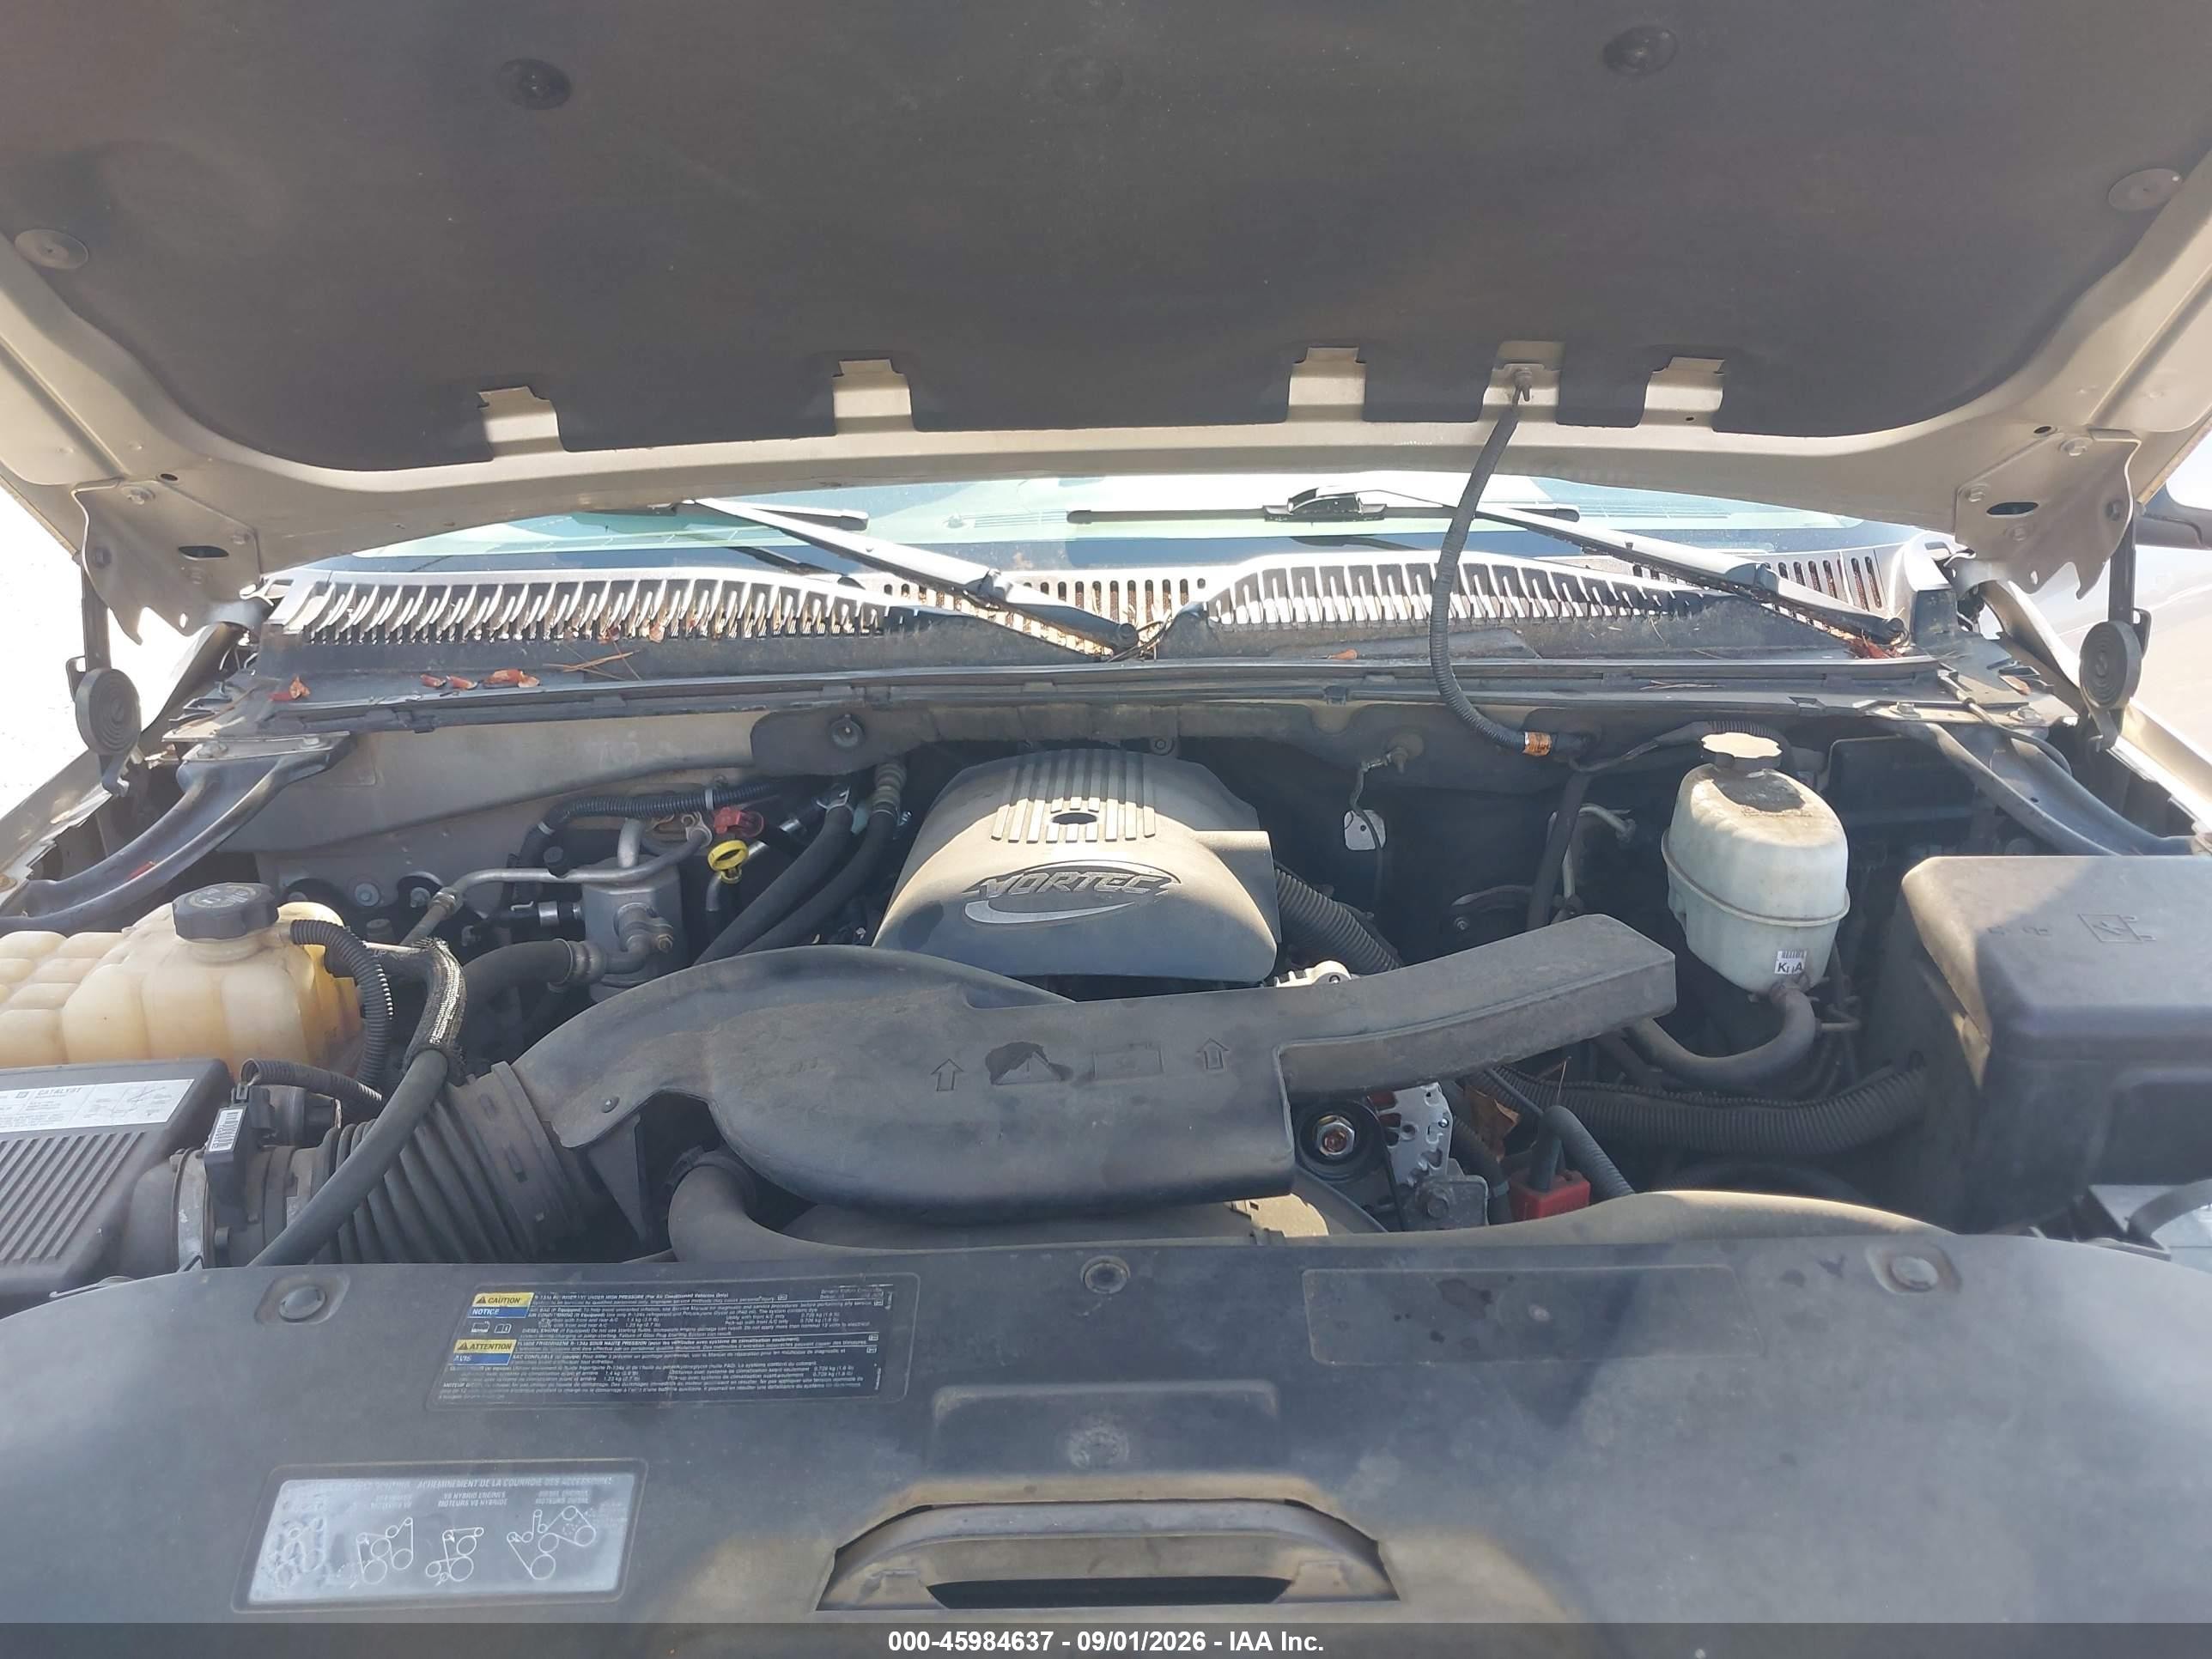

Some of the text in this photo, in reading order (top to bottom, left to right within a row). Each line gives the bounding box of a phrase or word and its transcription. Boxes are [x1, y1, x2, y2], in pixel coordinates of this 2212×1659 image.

[980, 871, 1163, 897] VORTEC
[479, 1479, 489, 1487] DE
[491, 1478, 501, 1487] LA
